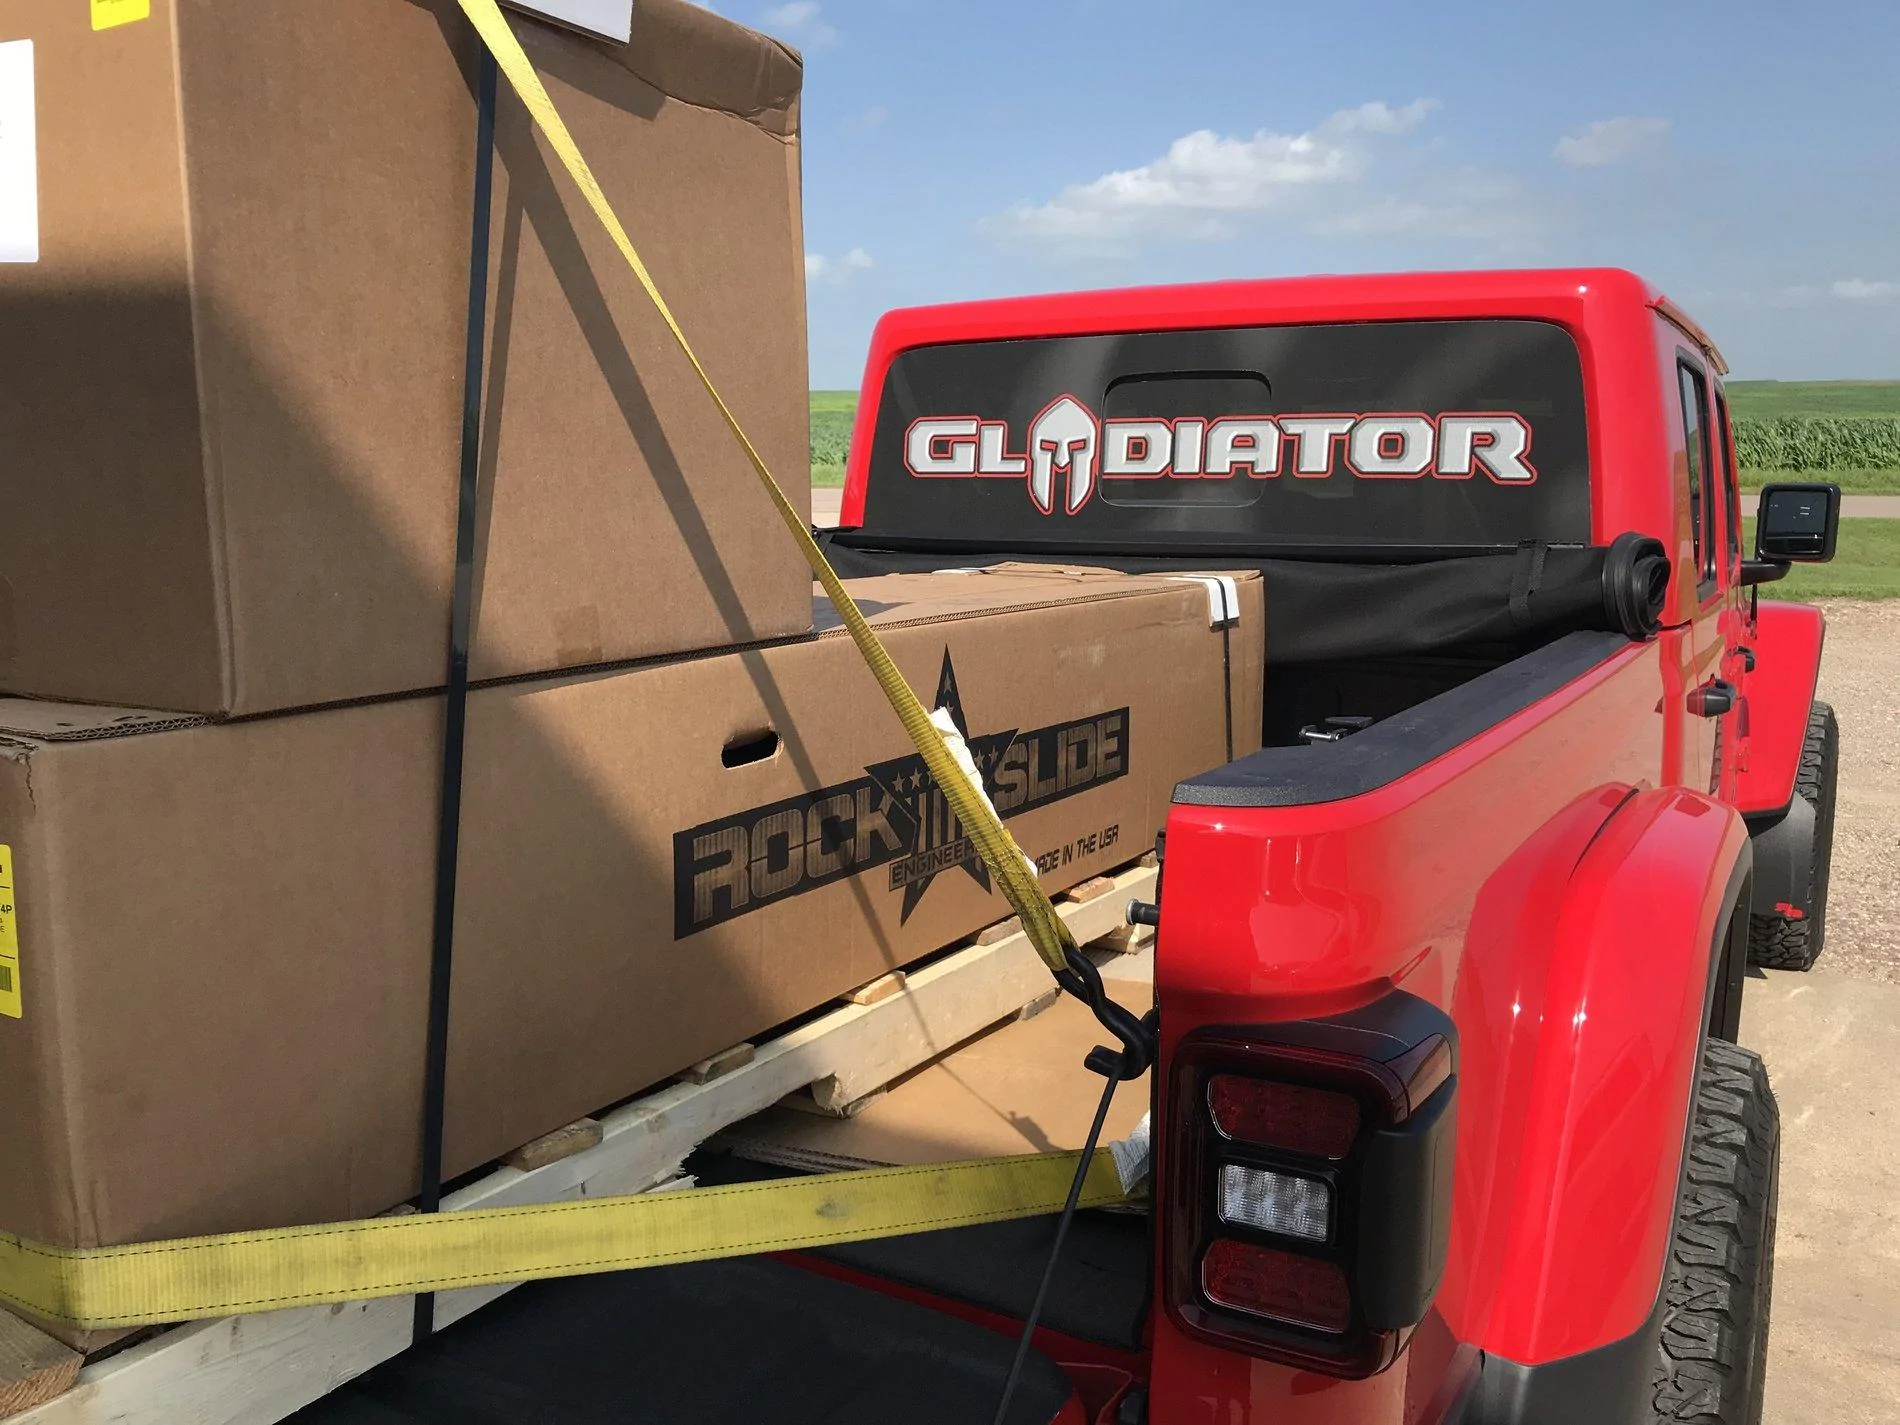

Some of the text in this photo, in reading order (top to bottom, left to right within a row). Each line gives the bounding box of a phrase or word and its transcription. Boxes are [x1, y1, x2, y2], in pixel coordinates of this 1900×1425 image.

[693, 714, 1122, 924] ROCK SLIDE
[1062, 843, 1074, 866] IN
[1077, 832, 1097, 858] THE
[1099, 824, 1119, 850] USA
